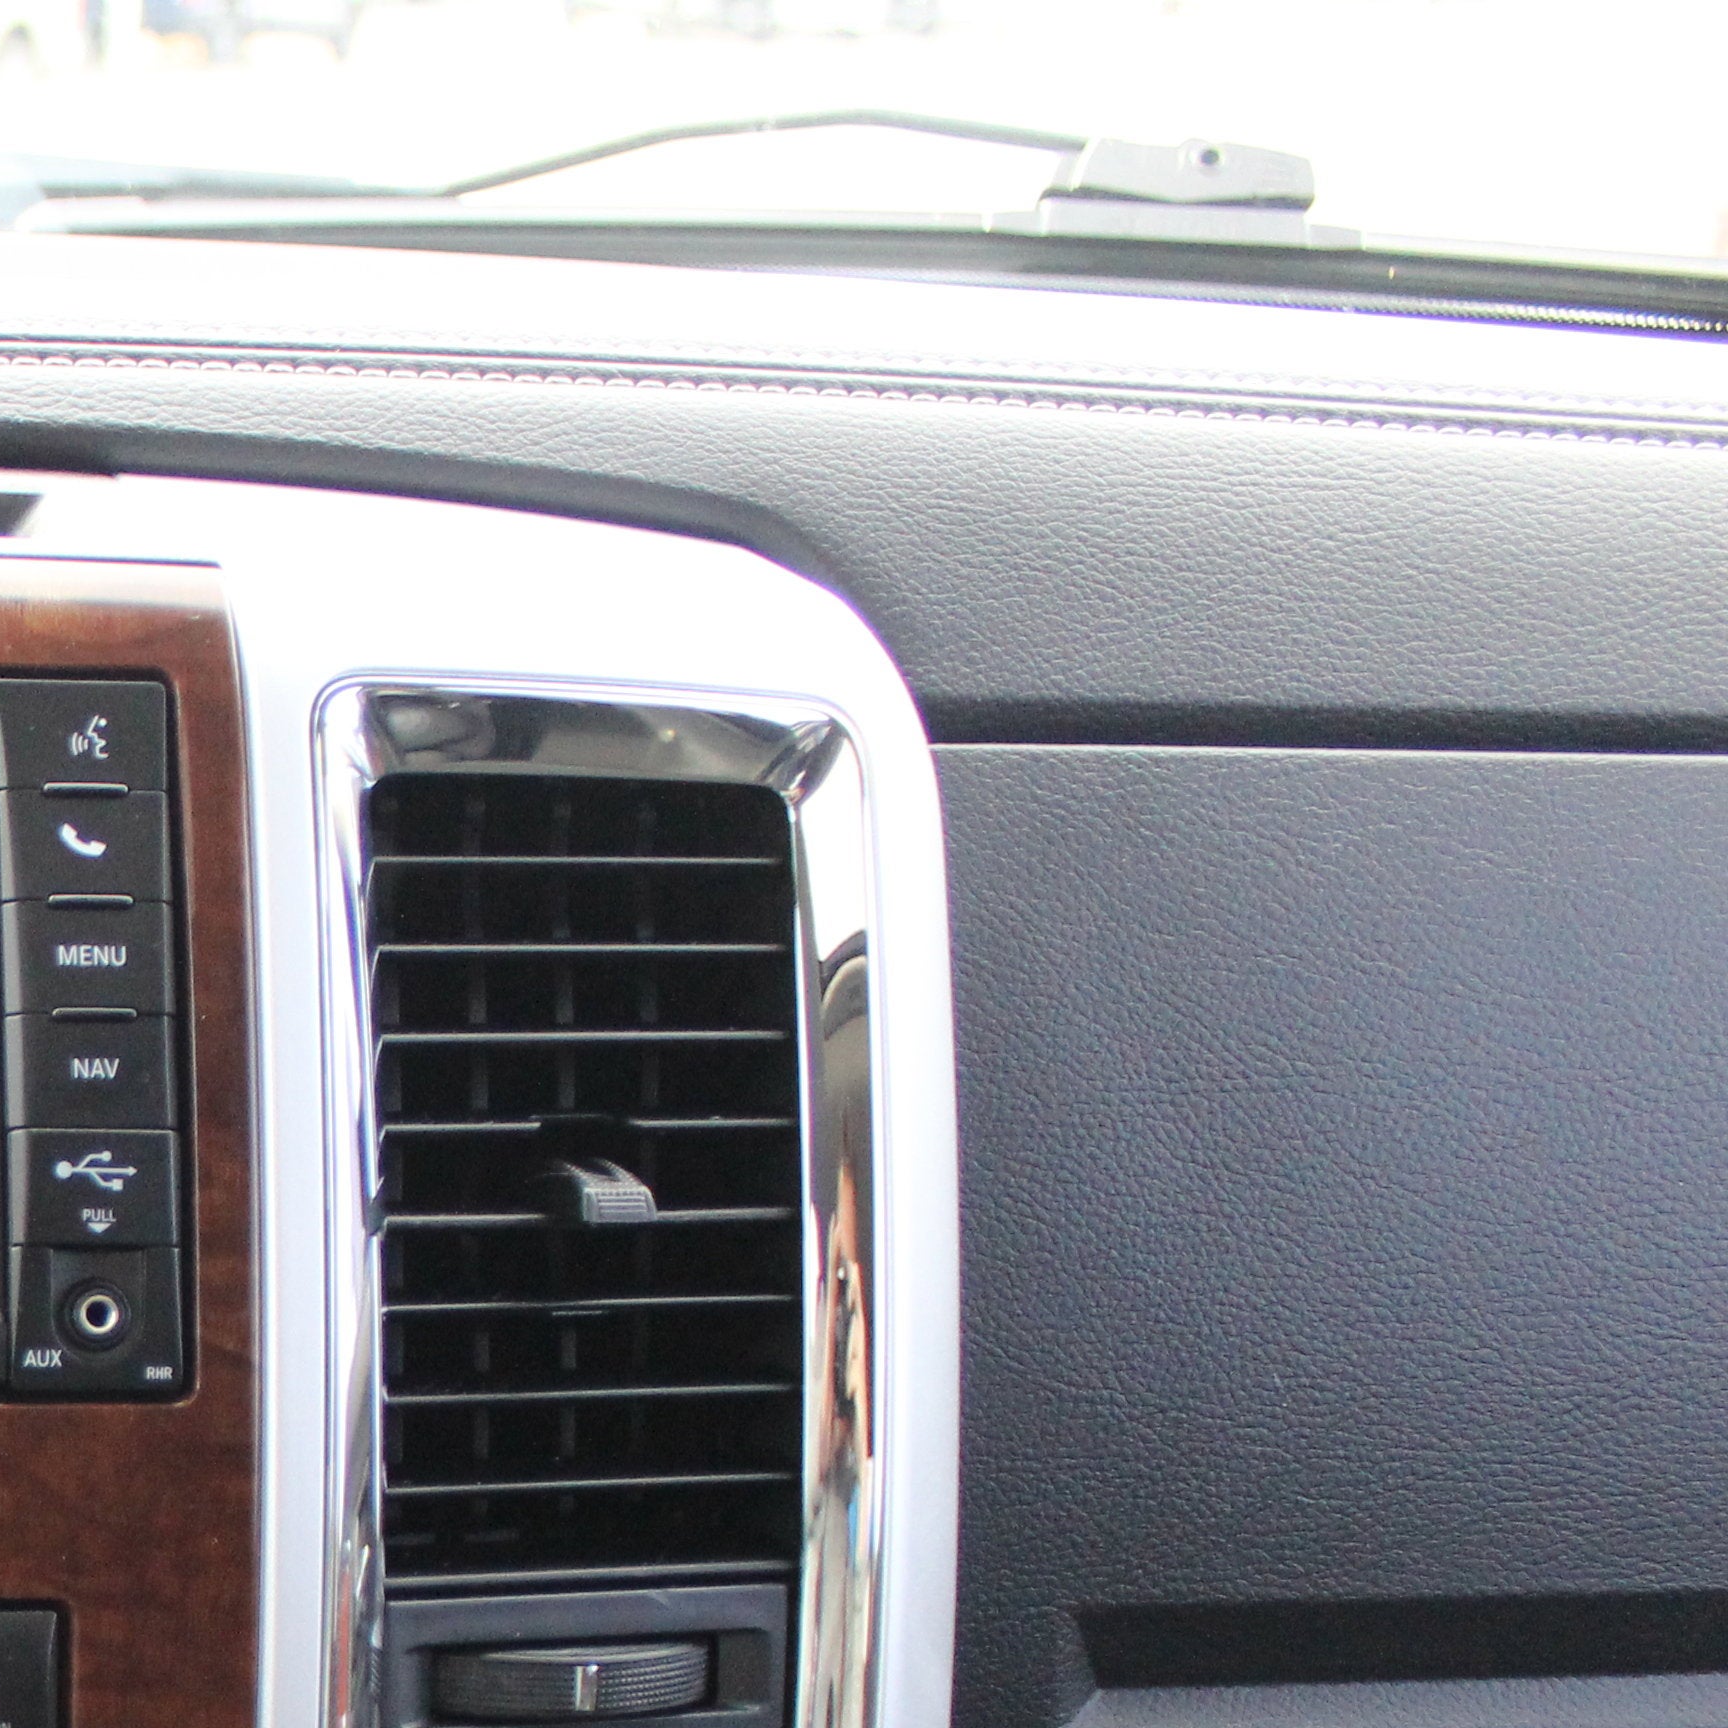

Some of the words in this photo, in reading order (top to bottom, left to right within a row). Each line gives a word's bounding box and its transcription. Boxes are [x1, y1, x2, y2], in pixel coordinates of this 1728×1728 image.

[57, 944, 128, 967] MENU
[72, 1057, 120, 1080] NAV
[82, 1208, 117, 1223] PULL
[24, 1350, 62, 1368] AUX
[146, 1365, 173, 1380] RHR
